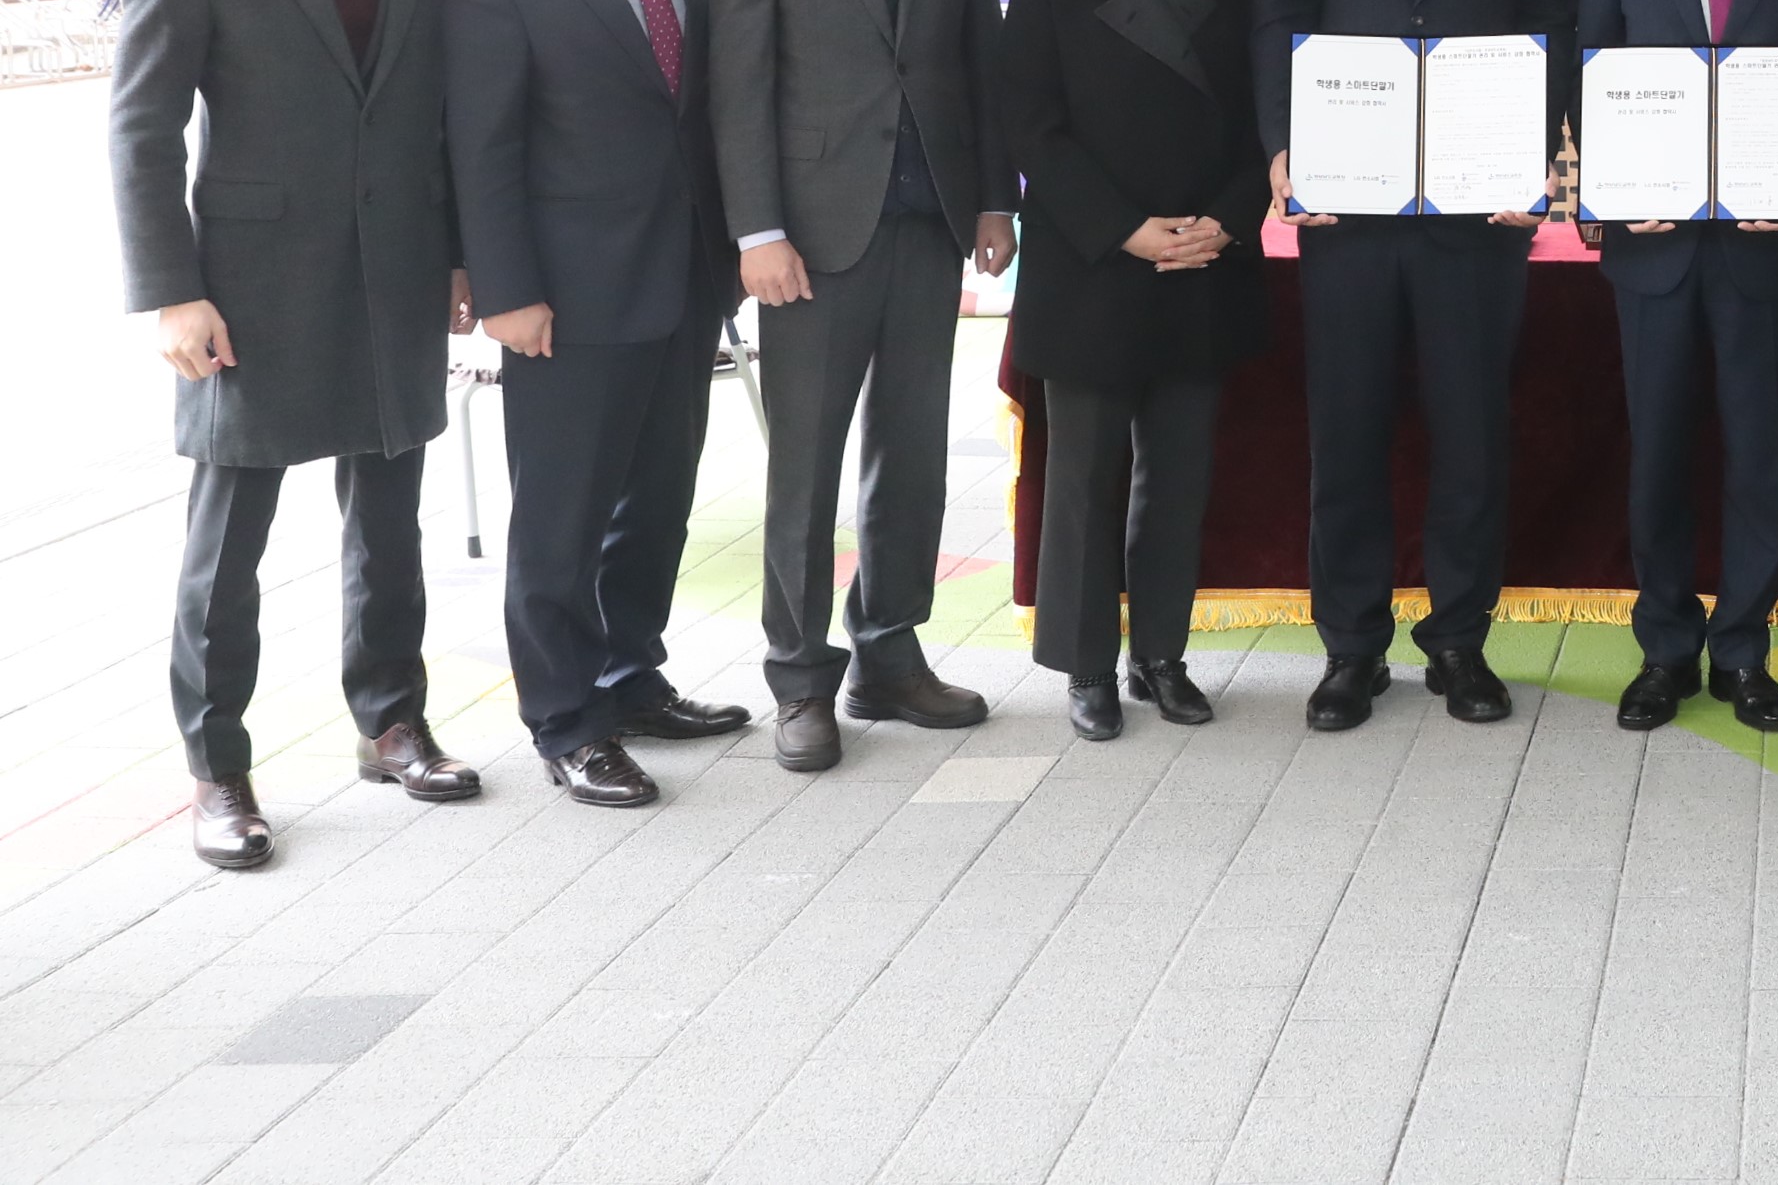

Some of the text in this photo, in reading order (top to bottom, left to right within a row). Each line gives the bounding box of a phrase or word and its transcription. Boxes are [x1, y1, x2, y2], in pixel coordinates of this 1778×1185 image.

[1316, 79, 1395, 91] 학생용 스마트단말기
[1606, 90, 1685, 100] 학생용 스마트단말기
